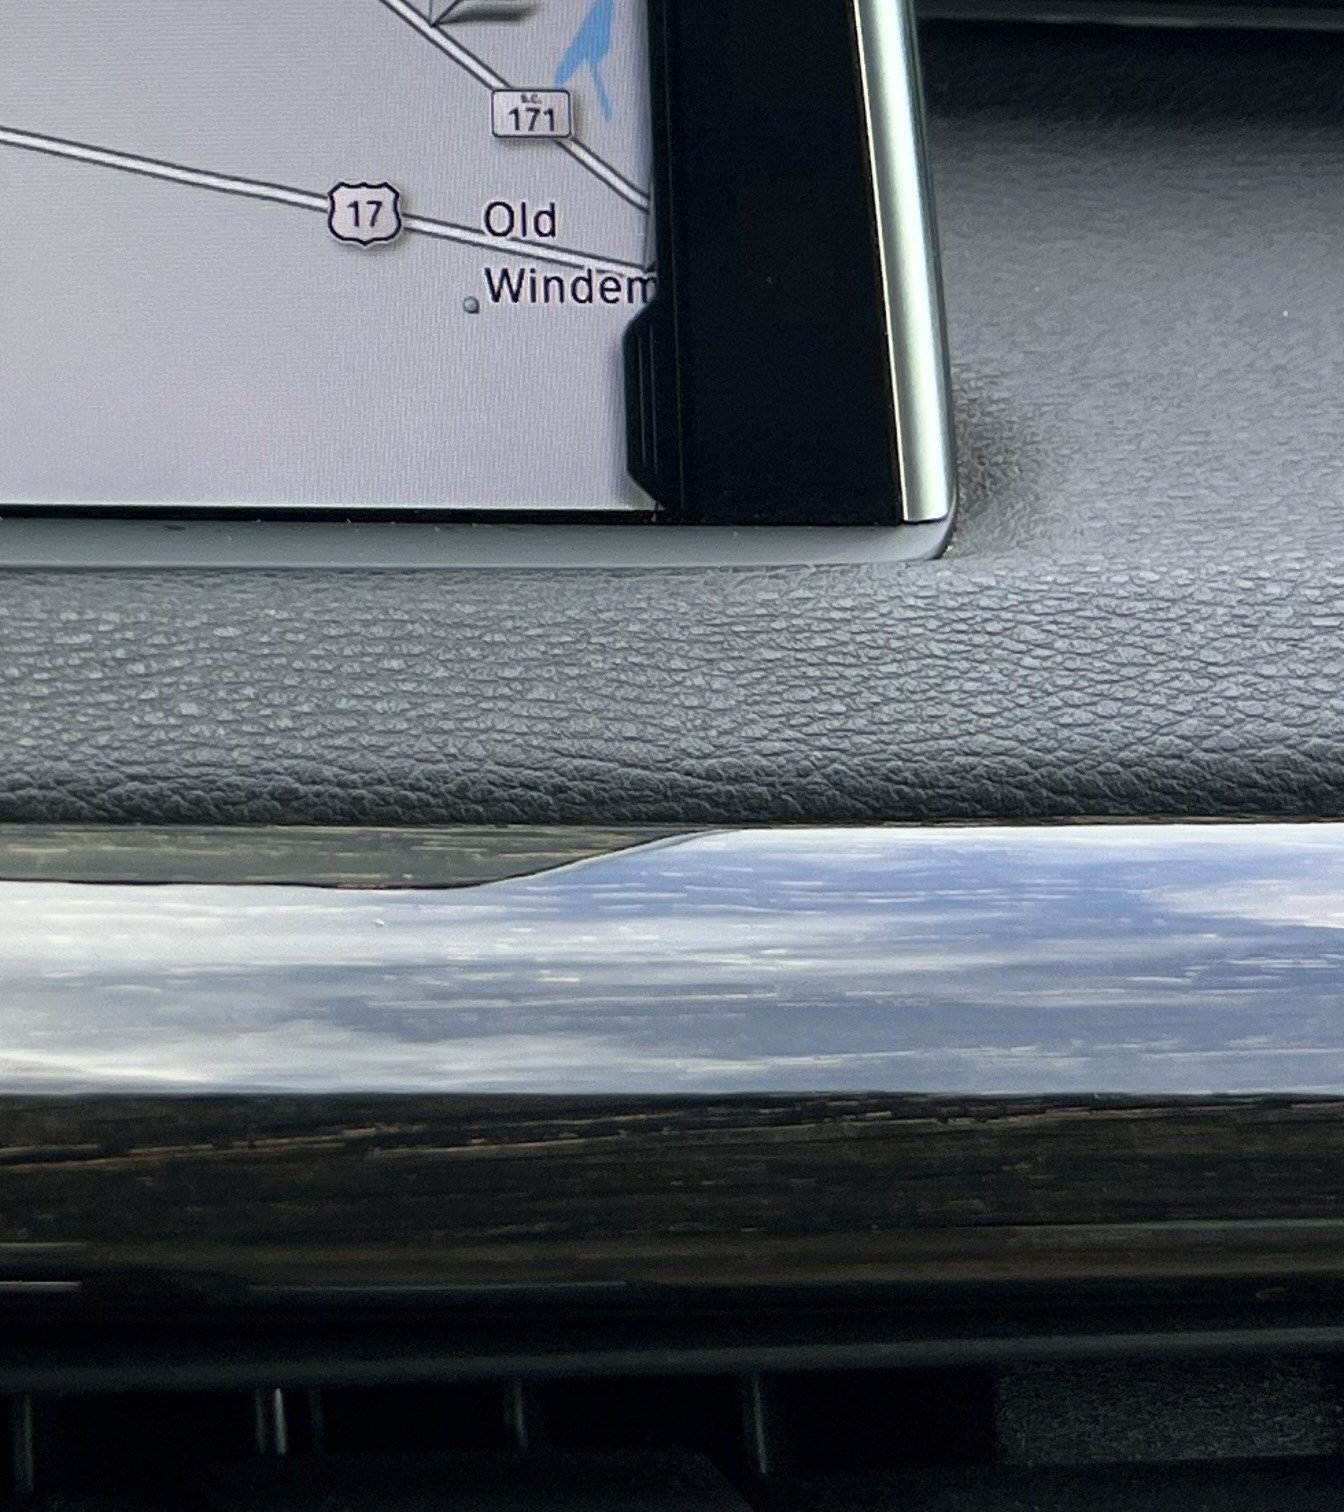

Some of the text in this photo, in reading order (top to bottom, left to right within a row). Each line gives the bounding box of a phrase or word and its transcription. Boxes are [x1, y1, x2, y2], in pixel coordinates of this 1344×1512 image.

[508, 107, 555, 132] 171
[347, 200, 383, 228] 17
[483, 201, 557, 238] Old
